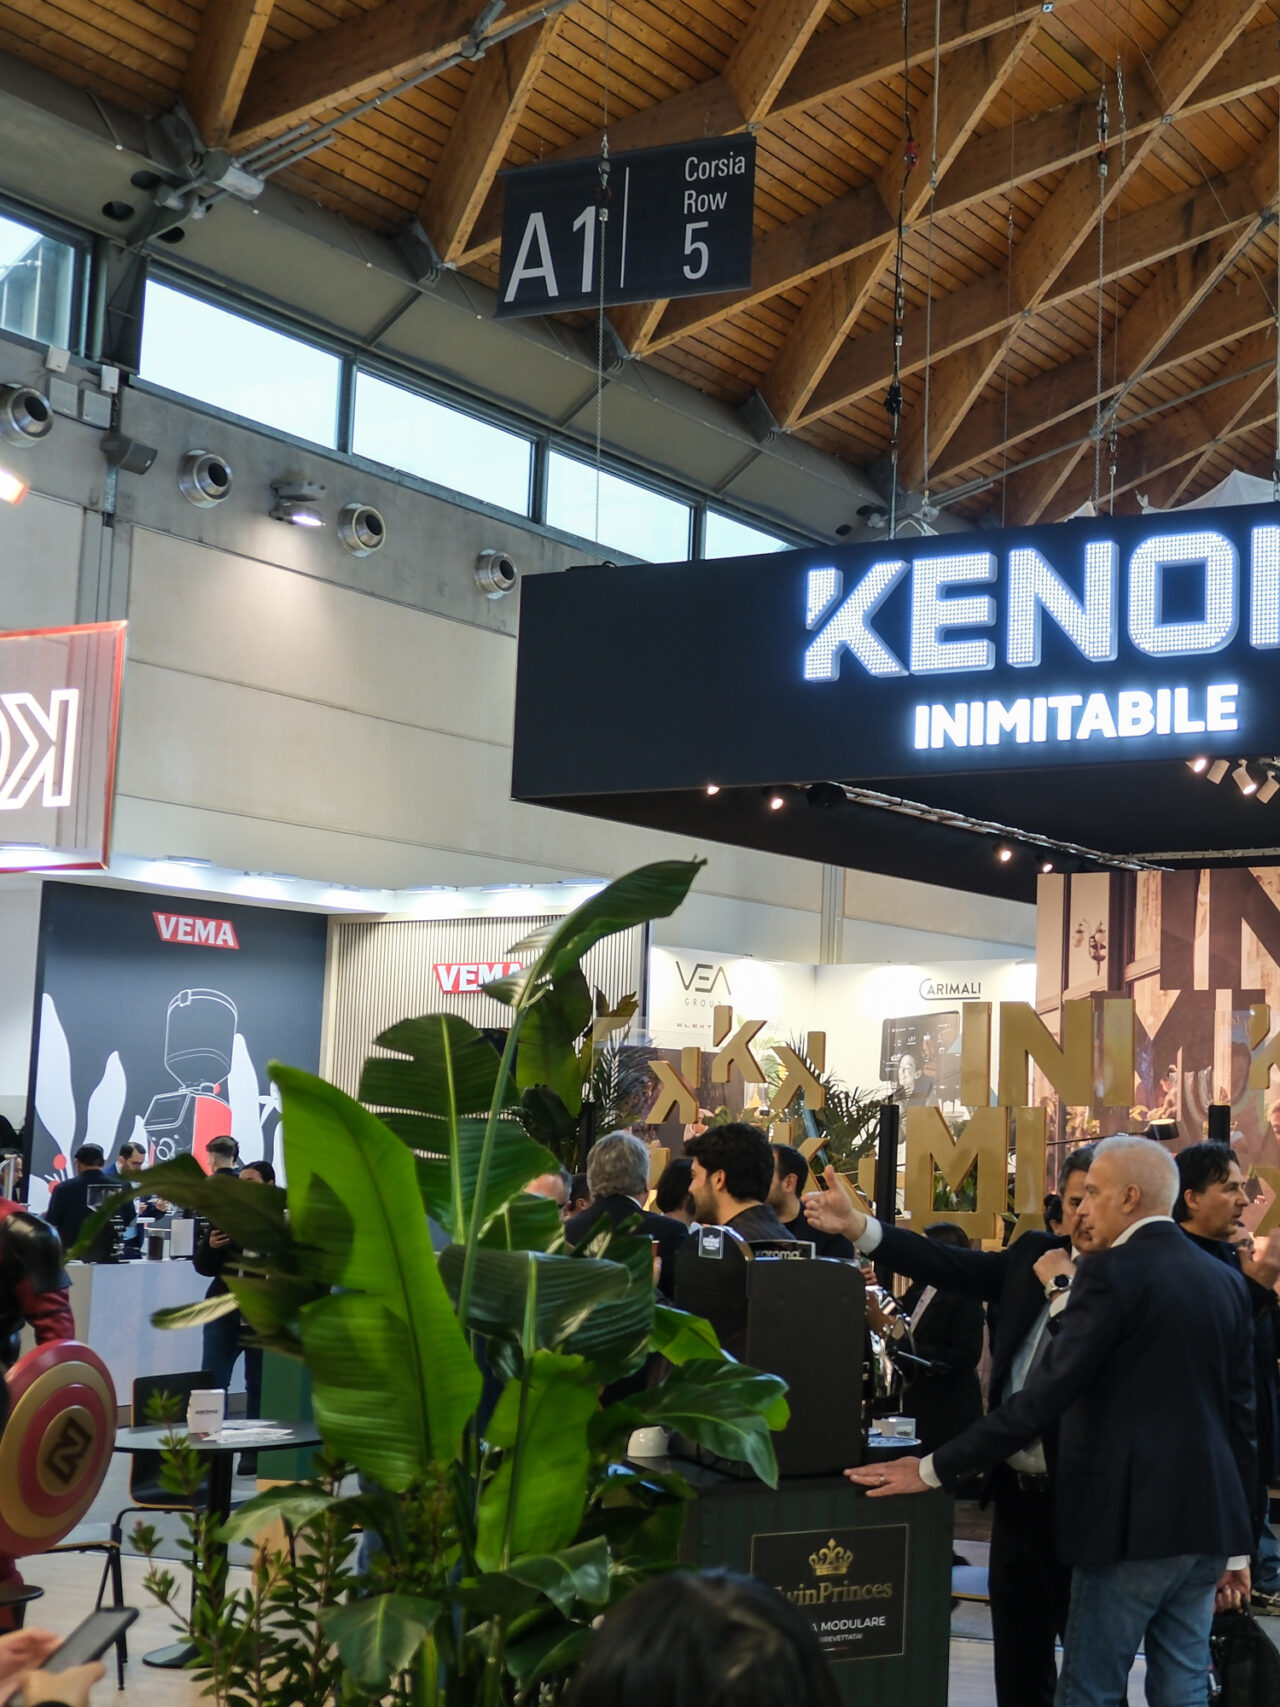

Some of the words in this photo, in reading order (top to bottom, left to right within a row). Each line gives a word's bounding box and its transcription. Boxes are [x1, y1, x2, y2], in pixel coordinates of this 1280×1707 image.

[684, 151, 746, 182] Corsia
[683, 189, 728, 215] Row
[503, 205, 597, 303] A1
[682, 220, 710, 281] 5
[913, 683, 1239, 751] INIMITABILE
[157, 914, 235, 947] VEMA
[919, 977, 982, 1001] CARIMALI
[820, 1616, 887, 1632] MODULARE
